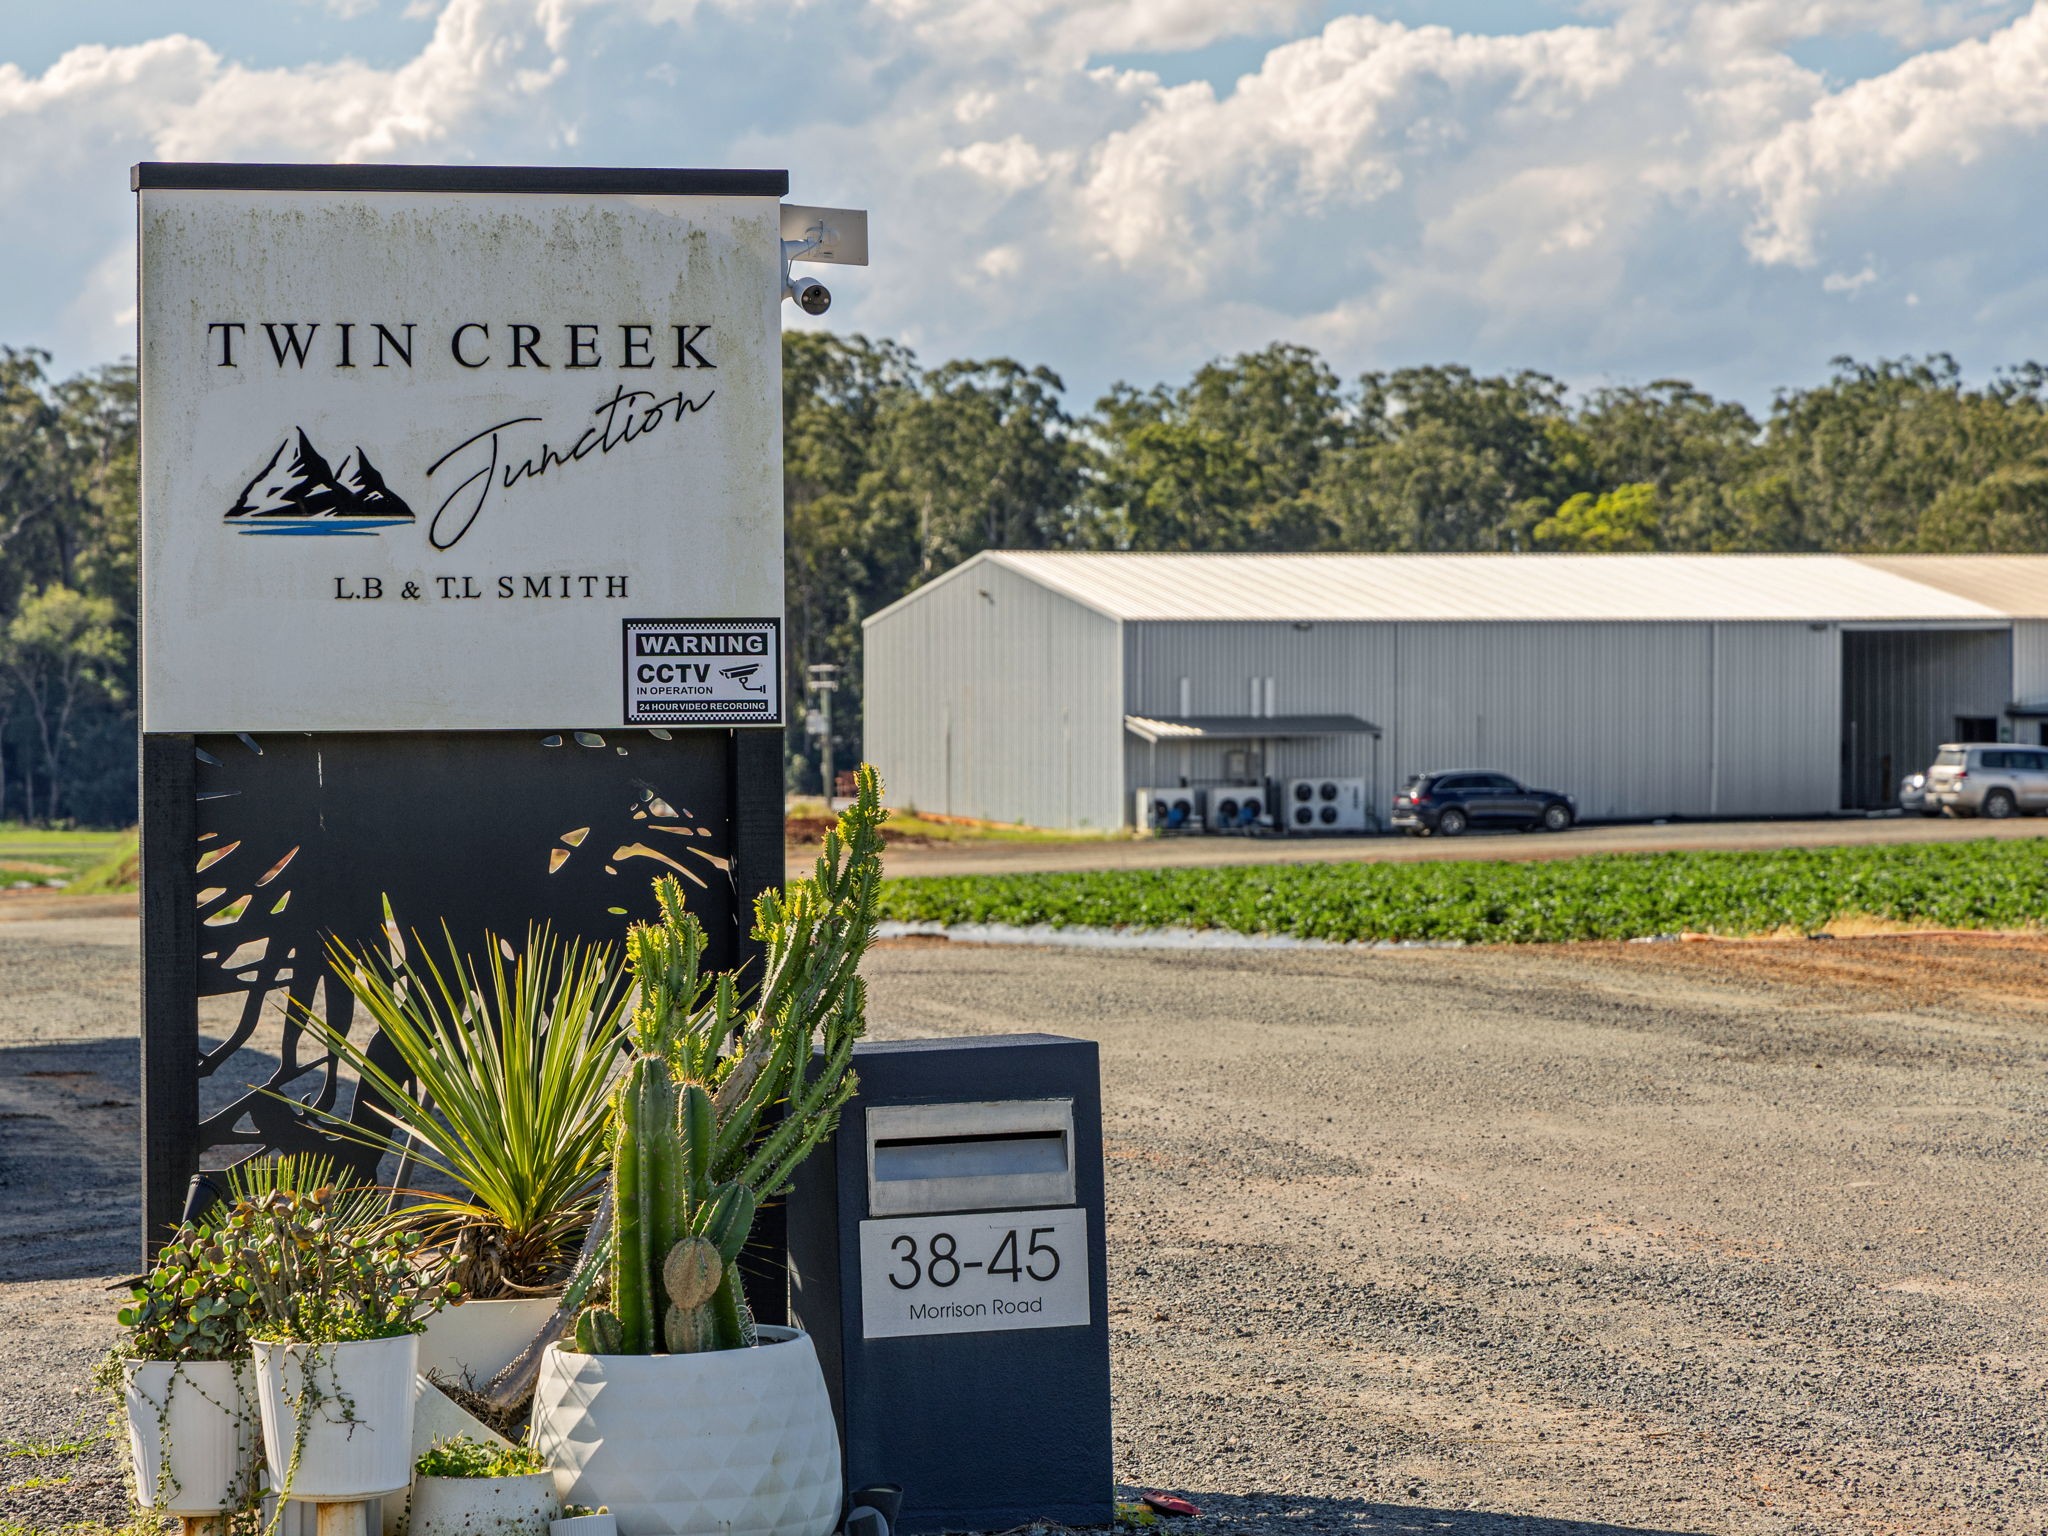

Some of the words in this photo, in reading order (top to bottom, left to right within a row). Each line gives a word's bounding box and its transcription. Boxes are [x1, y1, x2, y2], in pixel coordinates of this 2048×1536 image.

[208, 322, 418, 369] TWIN
[451, 323, 718, 370] CREEK
[426, 384, 716, 551] Junction
[334, 577, 383, 600] L.B
[401, 579, 421, 600] &
[498, 575, 629, 599] SMITH
[640, 635, 763, 654] WARNING
[637, 663, 711, 684] CCTV
[636, 687, 647, 695] IN
[650, 686, 713, 695] OPERATION
[652, 703, 679, 711] HOUR
[680, 703, 708, 711] VIDEO
[710, 702, 766, 711] RECORDING
[888, 1227, 1061, 1290] 38-45
[909, 1302, 987, 1320] Morrison
[992, 1296, 1043, 1315] Road
